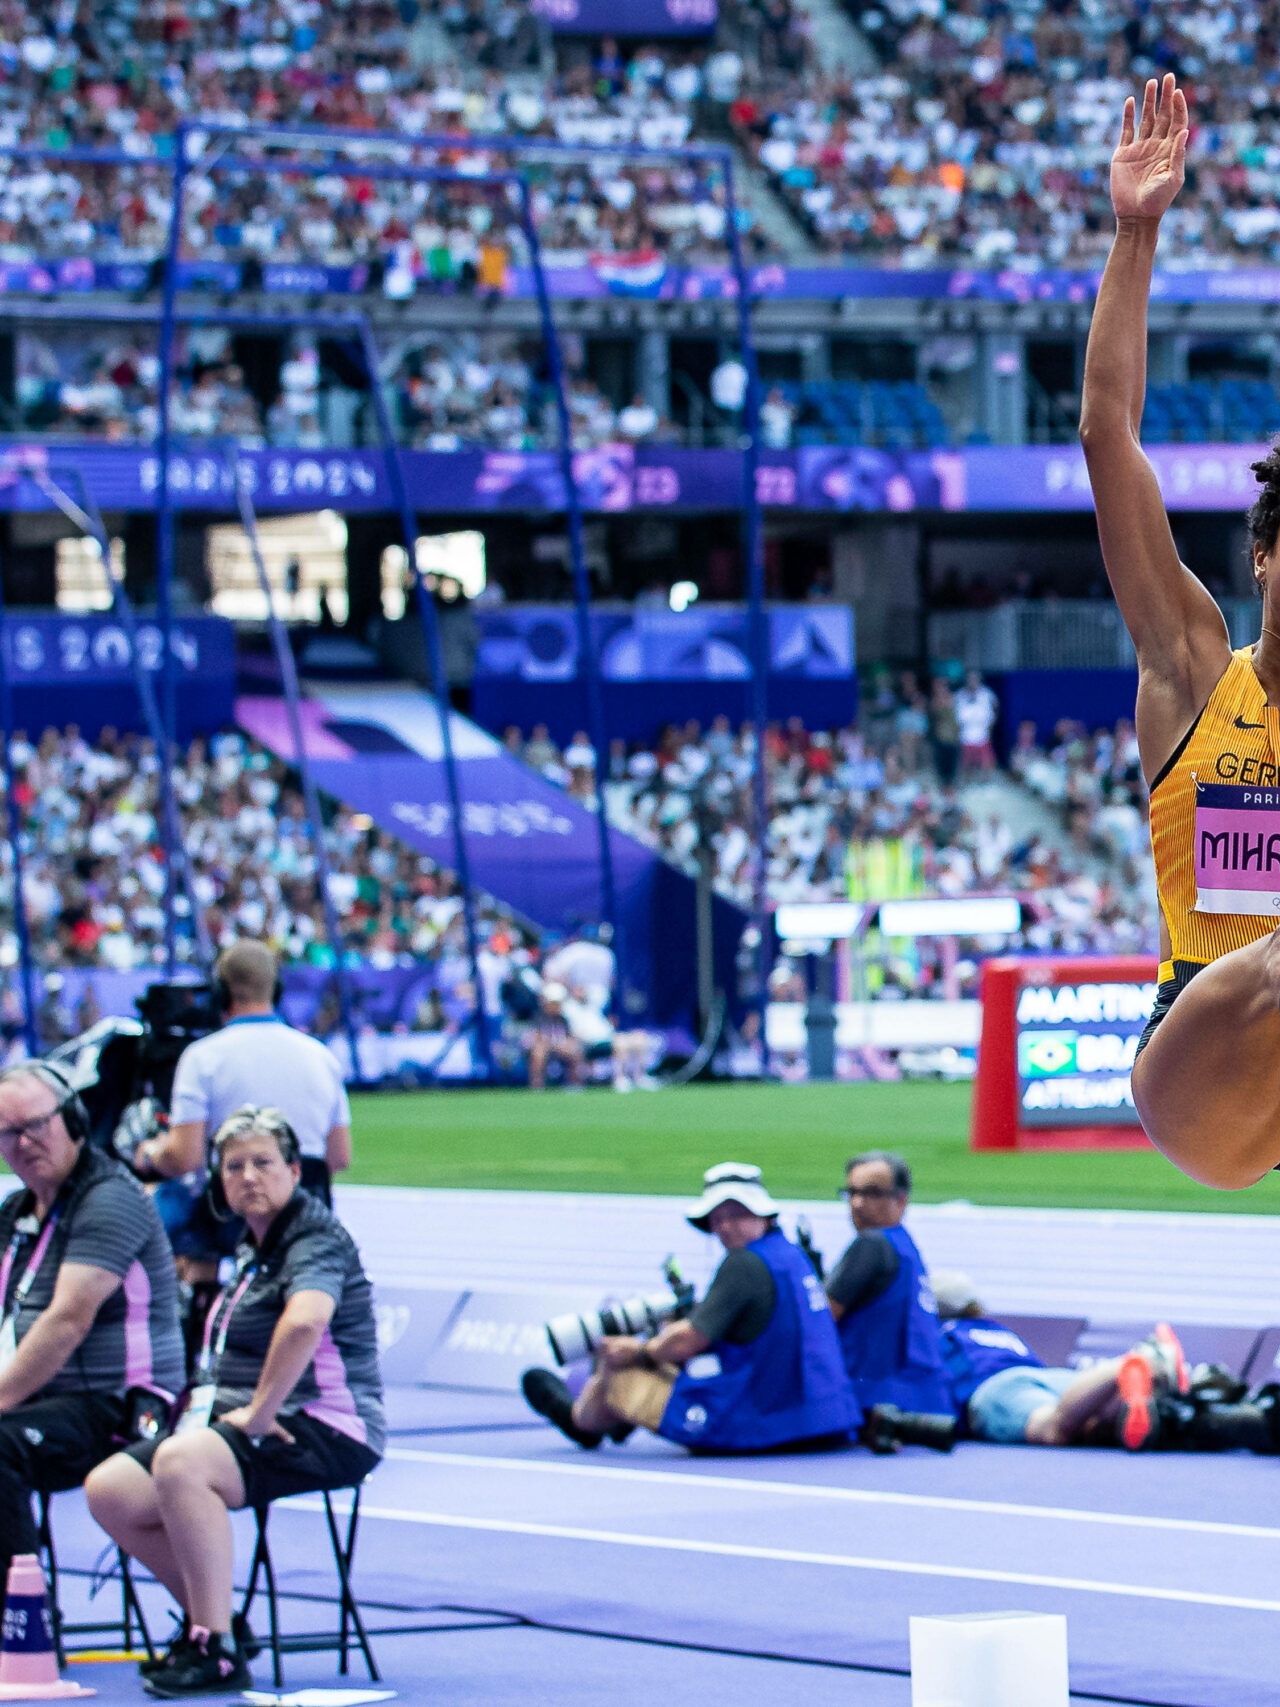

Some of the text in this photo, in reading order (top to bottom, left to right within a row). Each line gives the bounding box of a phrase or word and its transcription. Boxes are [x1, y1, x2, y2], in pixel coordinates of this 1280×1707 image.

[269, 457, 377, 497] 2024
[1171, 458, 1250, 495] 202
[58, 624, 199, 672] 2024
